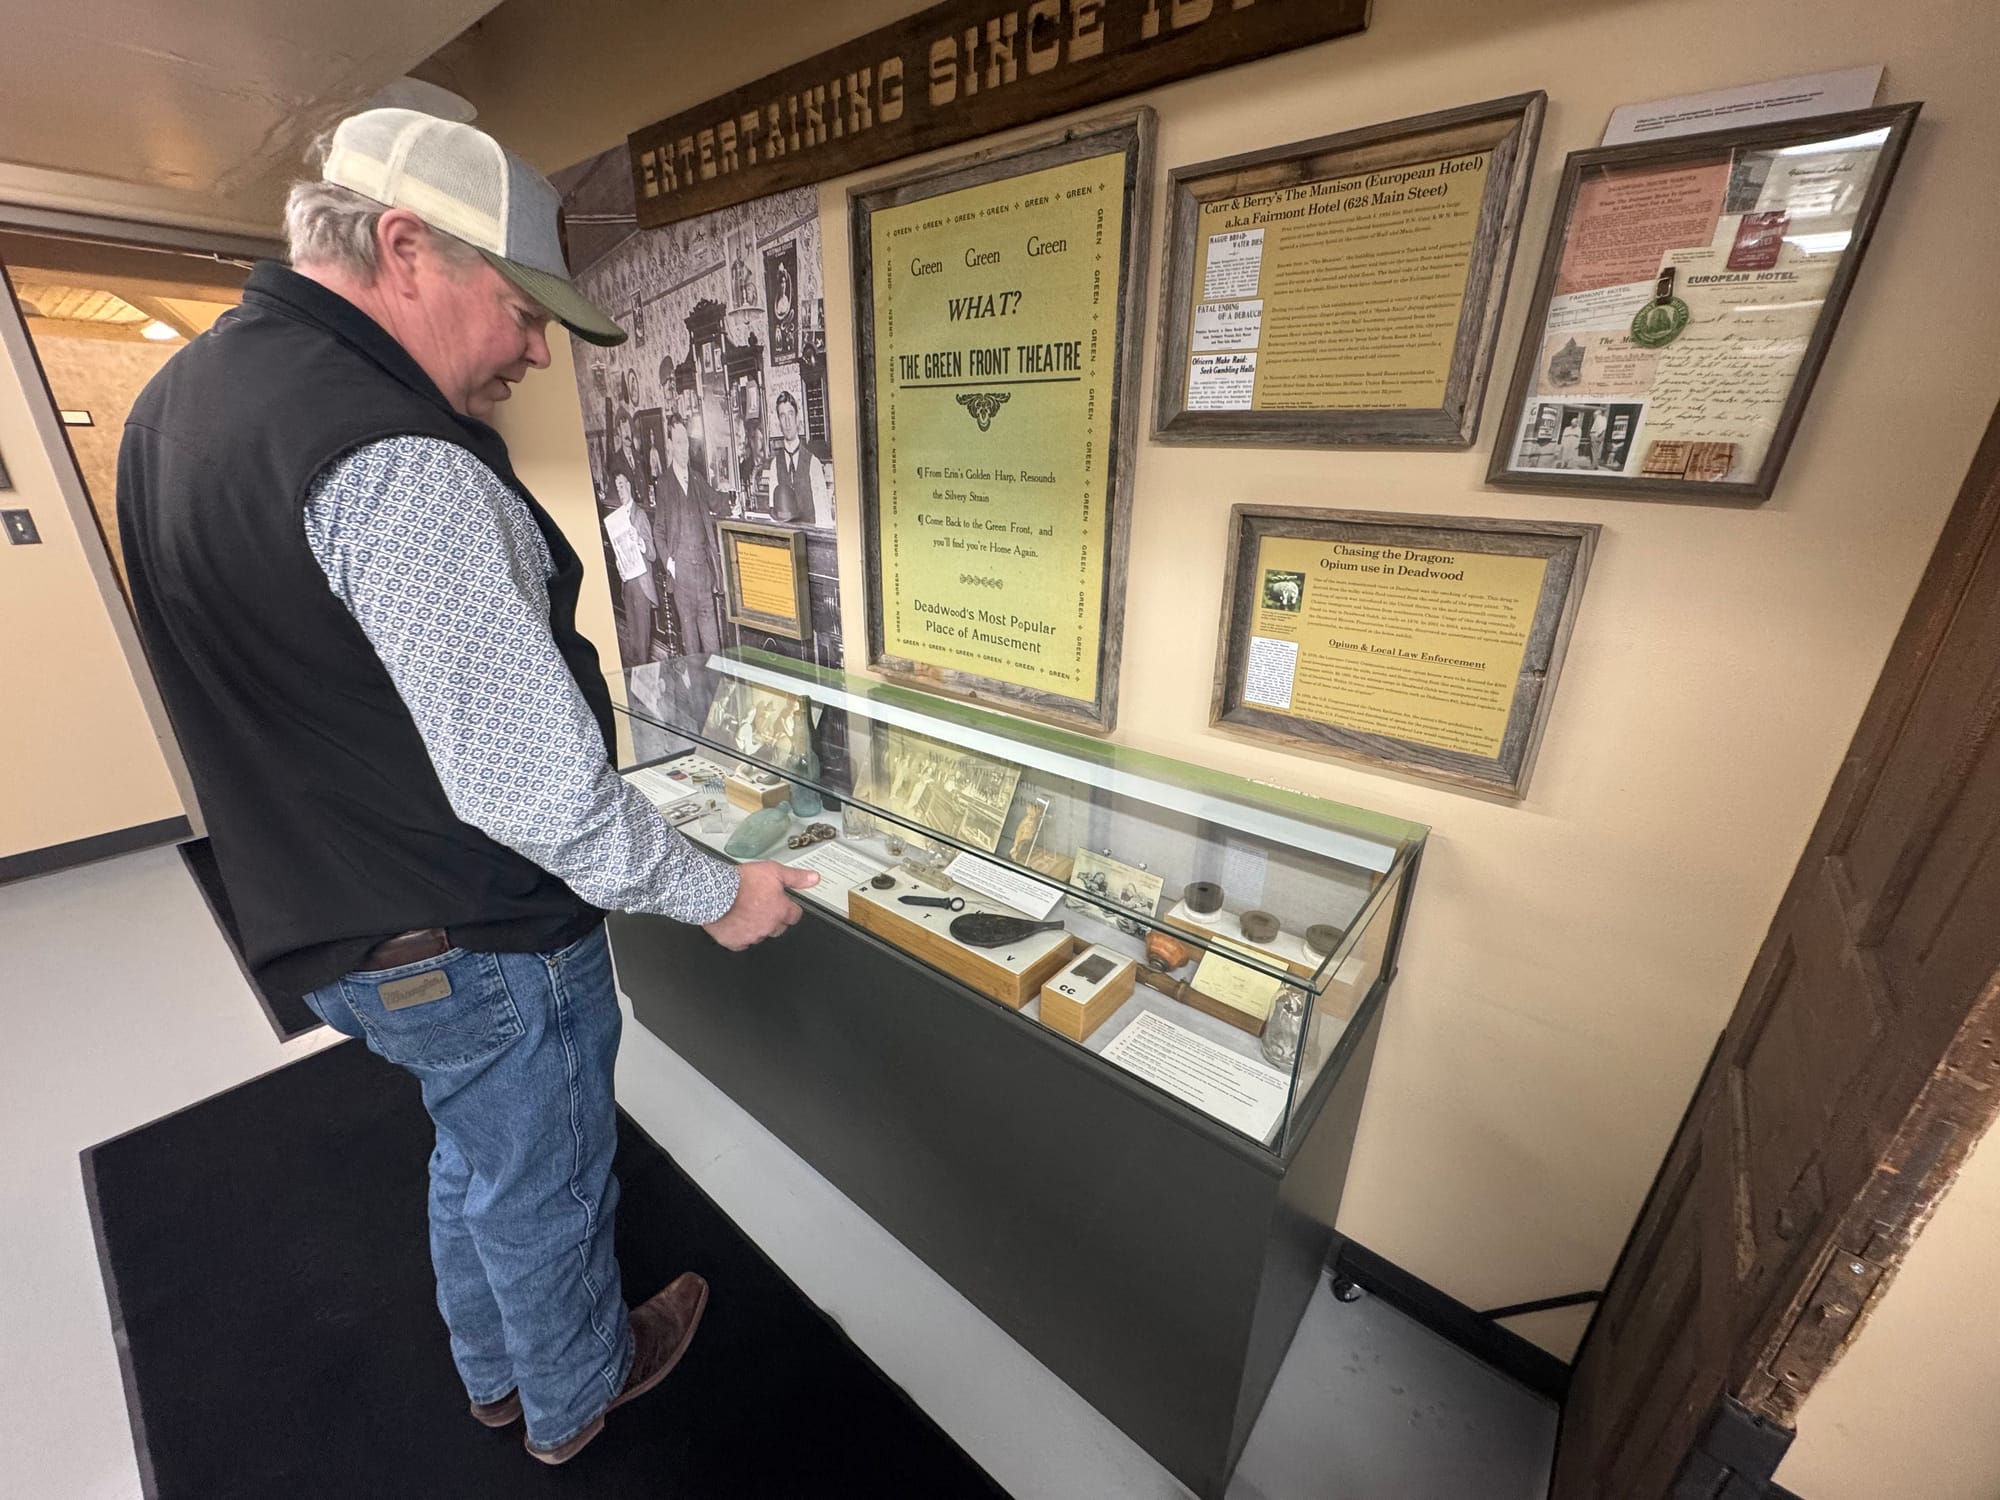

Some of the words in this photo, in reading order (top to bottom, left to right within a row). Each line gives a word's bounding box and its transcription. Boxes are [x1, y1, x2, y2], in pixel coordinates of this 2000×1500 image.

[640, 55, 904, 199] ENTERTAINING
[928, 0, 1104, 107] SINCE
[1066, 185, 1093, 199] GREEN
[1205, 202, 1230, 215] Carr
[1231, 198, 1240, 211] &
[1243, 191, 1283, 208] Berry's
[1285, 187, 1307, 202] The
[1309, 180, 1362, 197] Manison
[1365, 166, 1436, 190] (European
[1439, 155, 1484, 176] Hotel)
[986, 205, 1010, 217] GREEN
[1024, 195, 1049, 209] GREEN
[1225, 215, 1250, 229] a.k.a
[1252, 207, 1305, 225] Fairmont
[1308, 199, 1342, 216] Hotel
[1343, 194, 1369, 213] (628
[1371, 189, 1405, 207] Main
[1407, 182, 1449, 201] Steet)
[922, 219, 943, 231] GREEN
[954, 212, 976, 224] GREEN
[1096, 208, 1104, 246] GREEN
[911, 257, 943, 277] Green
[964, 247, 1001, 268] Green
[1026, 235, 1068, 257] Green
[1093, 269, 1101, 305] GREEN
[1688, 273, 1750, 284] EUROPEAN
[948, 289, 1023, 322] WHAT?
[1197, 304, 1216, 314] FATAL
[1218, 302, 1239, 312] ENDING
[1217, 312, 1226, 321] OF
[1227, 312, 1232, 320] A
[1090, 328, 1098, 363] GREEN
[899, 353, 921, 380] THE
[924, 349, 963, 379] GREEN
[968, 346, 1011, 376] FRONT
[1016, 340, 1083, 374] THEATRE
[1213, 365, 1240, 375] Gambling
[1087, 388, 1095, 421] GREEN
[1084, 441, 1093, 472] GREEN
[924, 467, 942, 479] From
[944, 467, 964, 480] Erin's
[965, 469, 991, 481] Golden
[994, 470, 1017, 485] Harp,
[1019, 471, 1057, 484] Resounds
[932, 489, 943, 500] the
[944, 490, 967, 503] Silvery
[969, 491, 990, 503] Strain
[1082, 492, 1090, 523] GREEN
[925, 514, 944, 526] Come
[945, 516, 962, 528] Back
[963, 519, 970, 529] to
[972, 518, 984, 530] the
[985, 519, 1007, 533] Green
[1010, 522, 1034, 537] Front,
[1038, 525, 1053, 537] and
[932, 537, 951, 549] you'll
[952, 538, 965, 549] find
[966, 540, 988, 553] you're
[989, 542, 1012, 555] Home
[1013, 545, 1039, 559] Again.
[1079, 544, 1088, 573] GREEN
[1333, 544, 1380, 560] Chasing
[1382, 548, 1402, 560] the
[1403, 550, 1455, 565] Dragon:
[1320, 558, 1358, 571] Opium
[1360, 565, 1380, 574] use
[1383, 564, 1395, 575] in
[1397, 565, 1465, 581] Deadwood
[1077, 591, 1085, 619] GREEN
[914, 599, 975, 621] Deadwood's
[978, 609, 1007, 626] Most
[1010, 614, 1057, 636] Popular
[902, 638, 920, 648] GREEN
[925, 620, 955, 636] Place
[957, 626, 969, 640] of
[971, 627, 1042, 654] Amusement
[928, 643, 947, 652] GREEN
[955, 648, 974, 658] GREEN
[983, 654, 1002, 664] GREEN
[1328, 638, 1359, 650] Opium
[1360, 643, 1369, 651] &
[1370, 644, 1396, 655] Local
[1398, 649, 1418, 659] Law
[1420, 651, 1486, 669] Enforcement
[1014, 661, 1035, 672] GREEN
[1048, 669, 1071, 681] GREEN
[1059, 984, 1076, 996] CC
